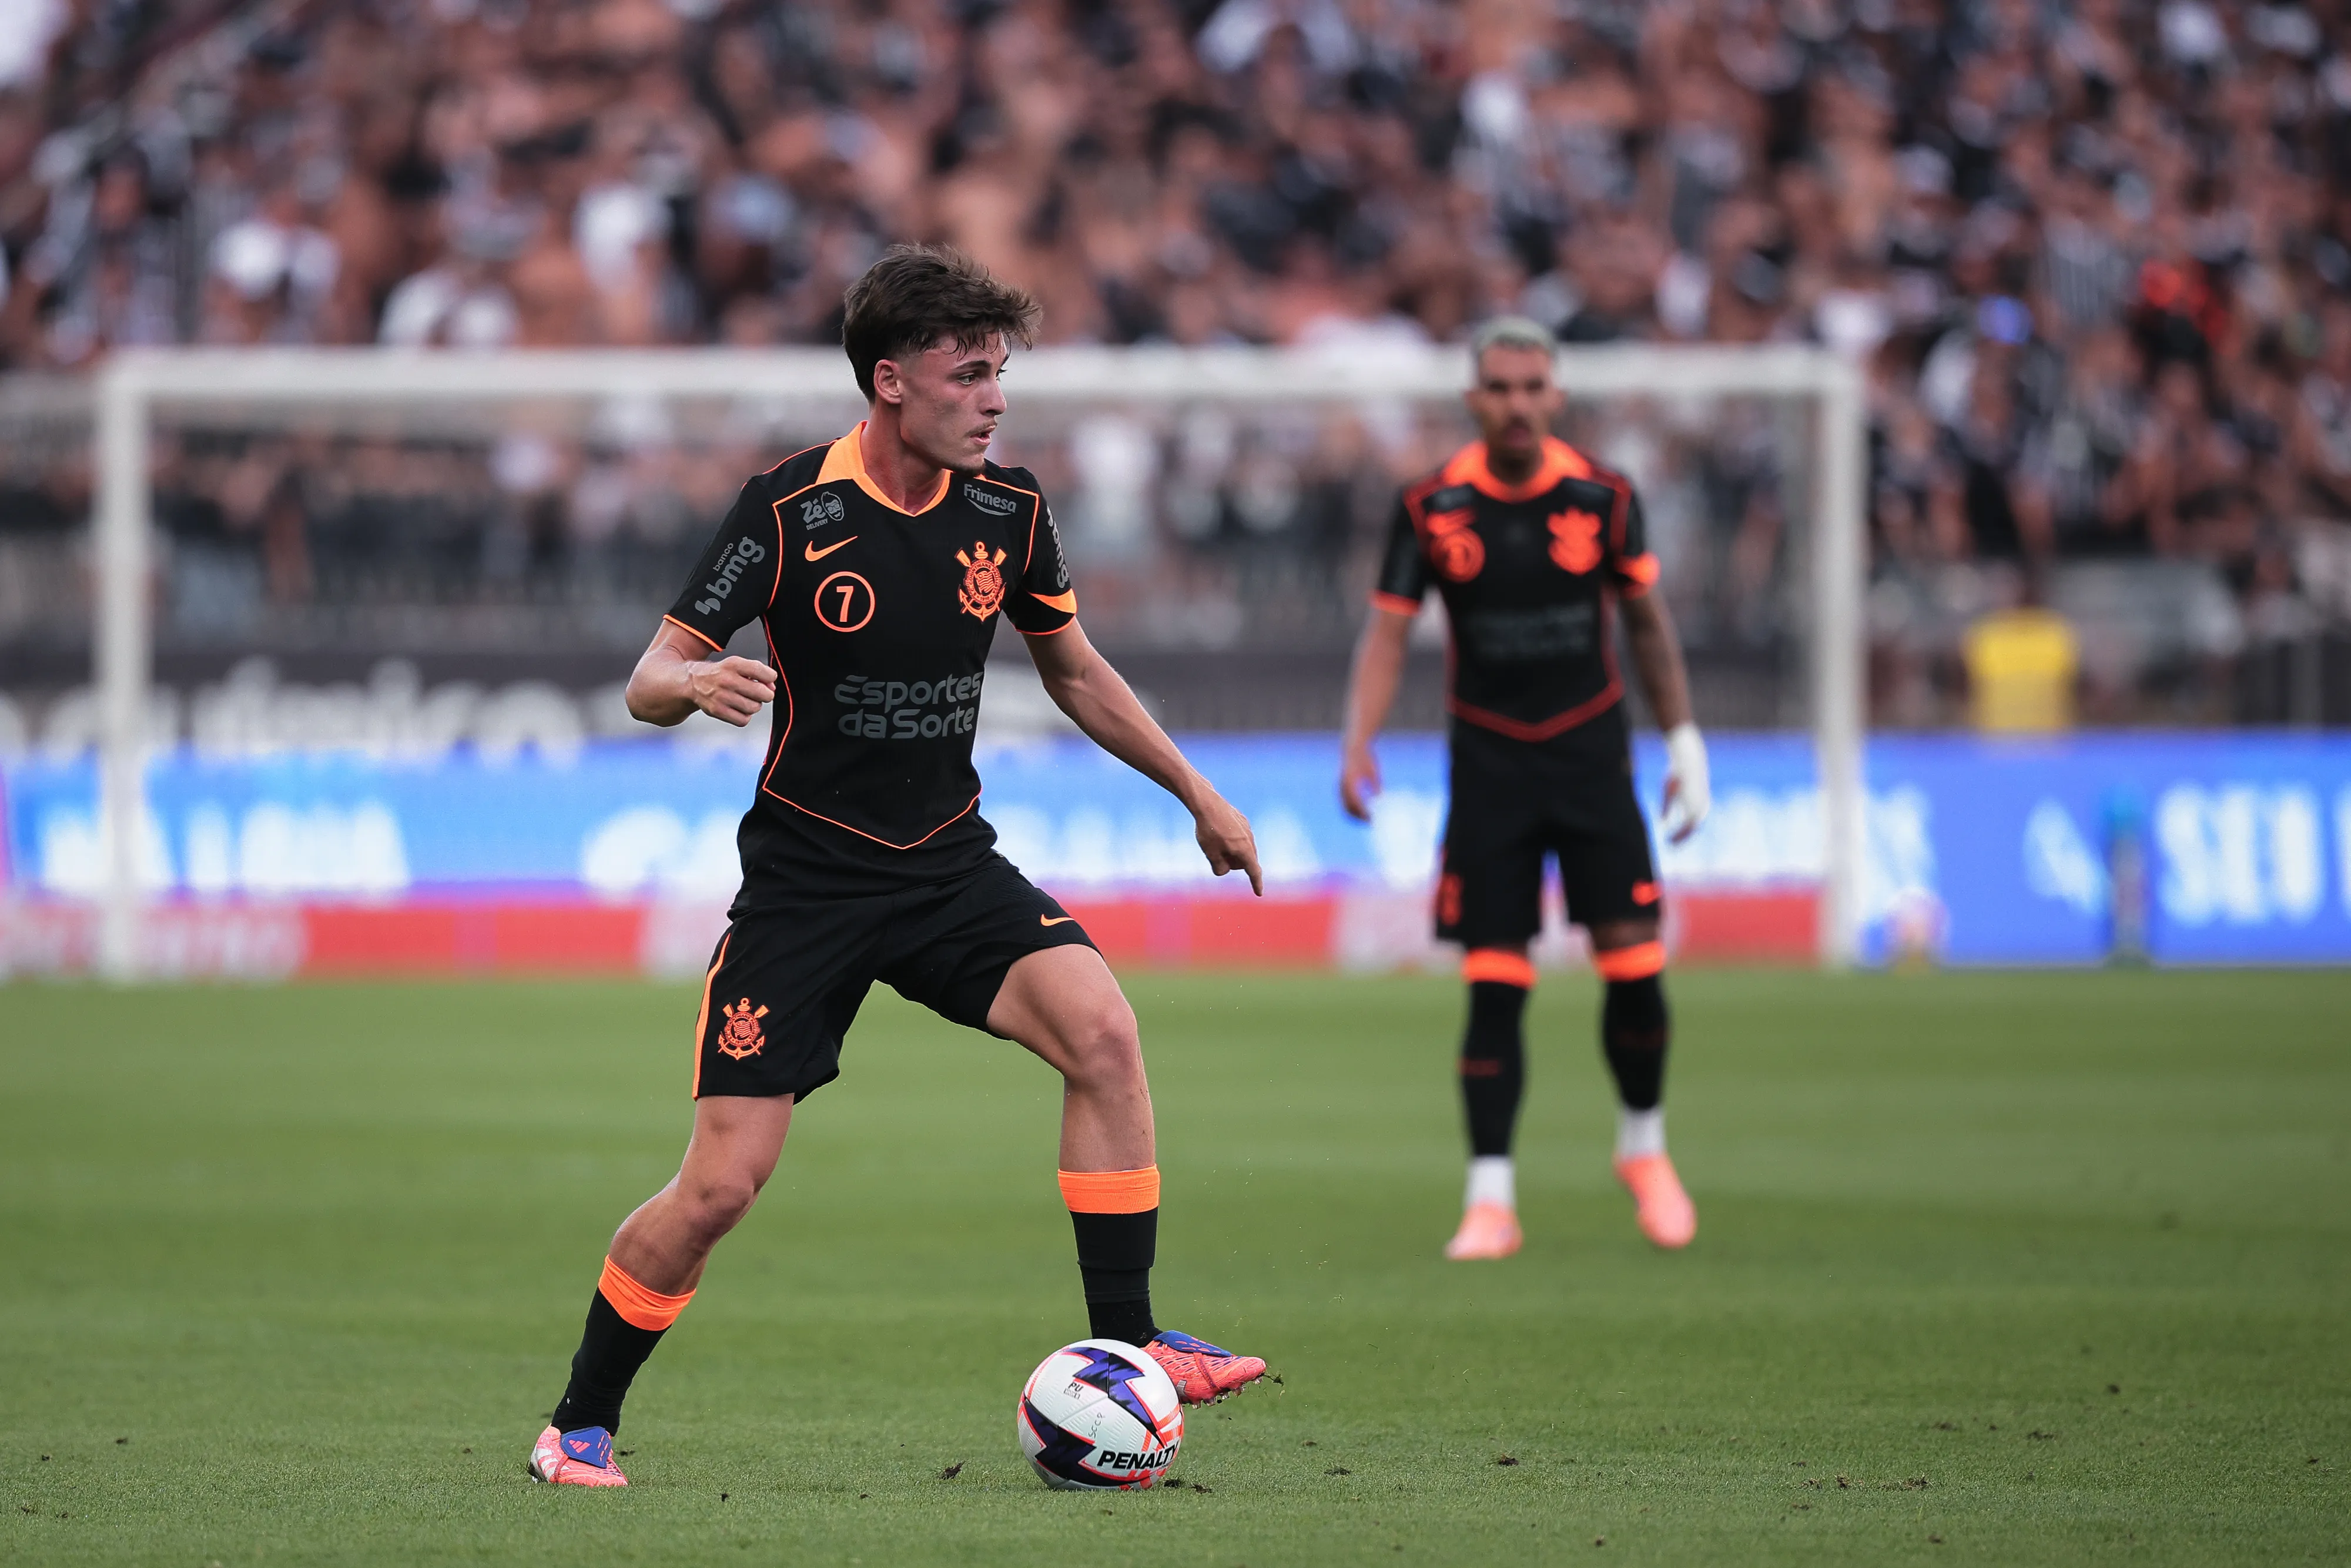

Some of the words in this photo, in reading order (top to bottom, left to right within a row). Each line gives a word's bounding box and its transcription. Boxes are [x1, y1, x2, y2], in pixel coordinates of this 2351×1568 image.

[800, 498, 826, 524] Zé
[964, 484, 1017, 513] Frimesa
[806, 518, 828, 530] DELIVERY
[706, 536, 765, 599] bmg
[713, 543, 734, 571] banco
[836, 585, 854, 622] 7
[834, 672, 983, 714] Esportes
[1068, 1381, 1084, 1392] PU
[1097, 1440, 1180, 1470] PENALTY
